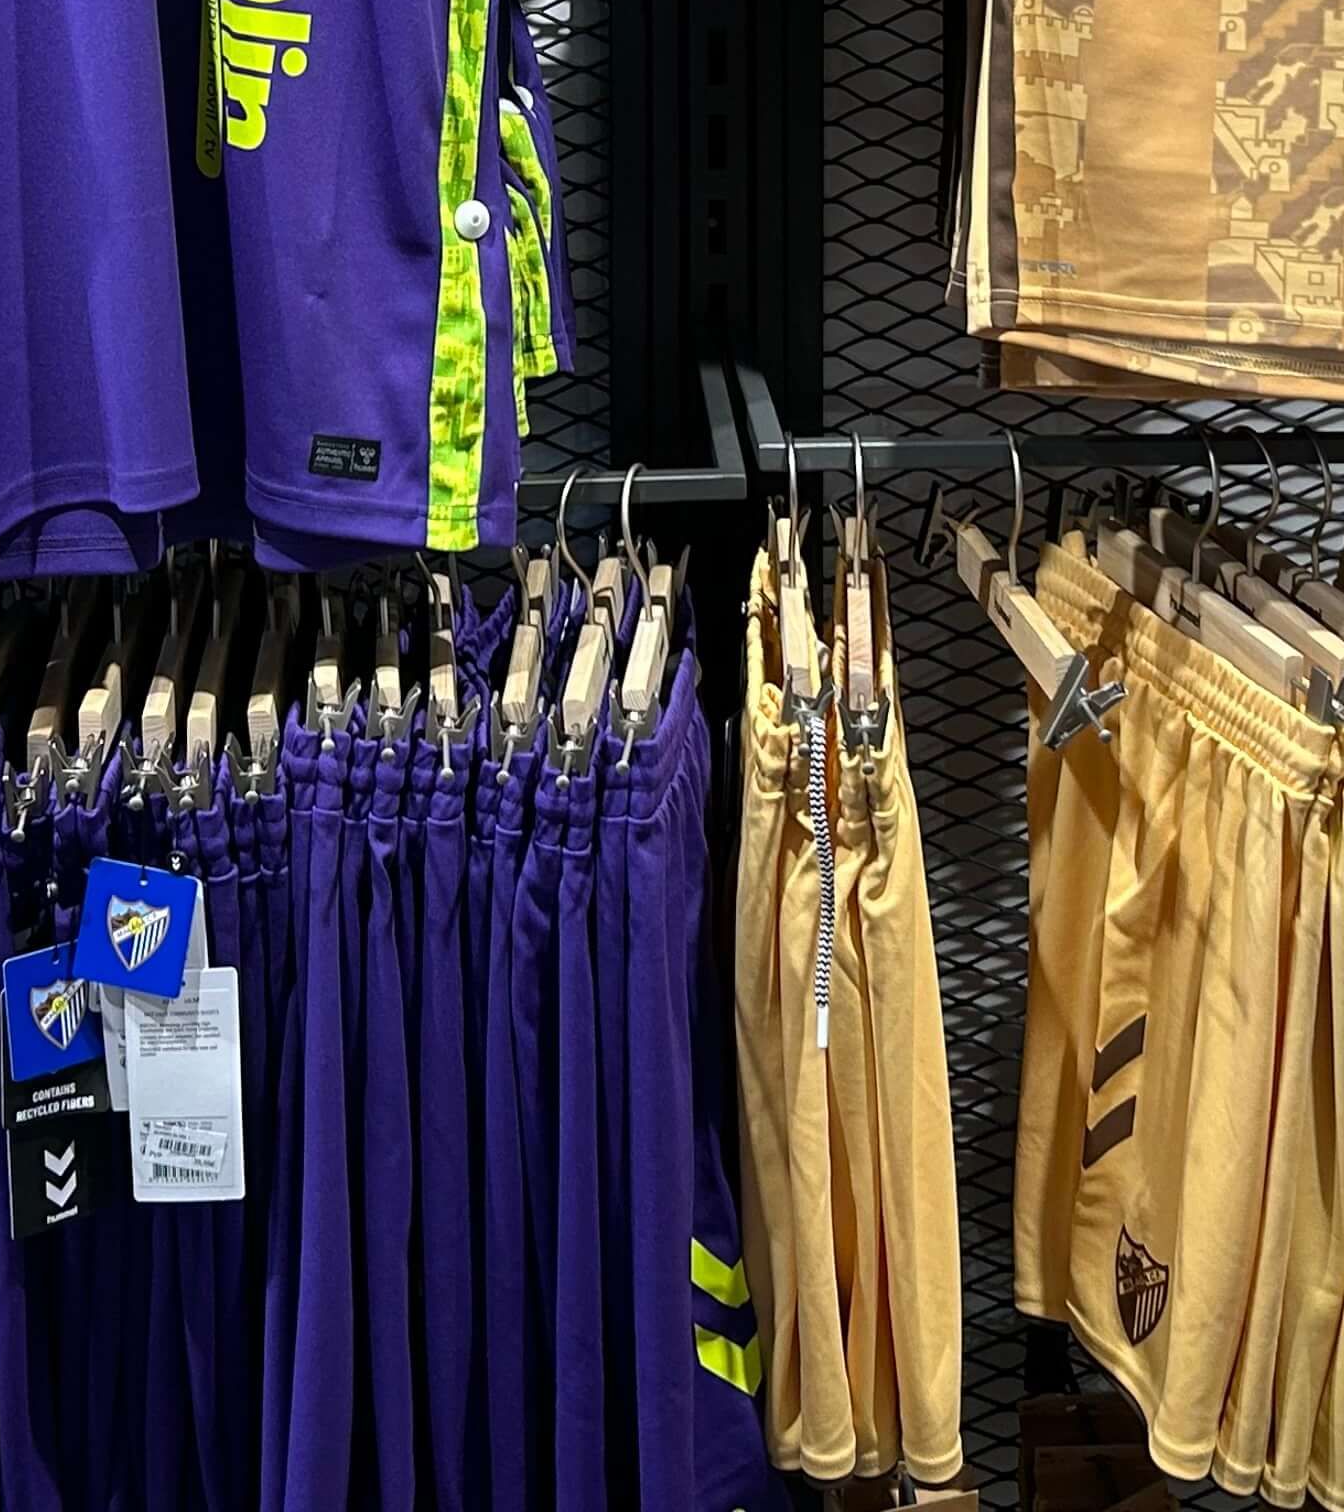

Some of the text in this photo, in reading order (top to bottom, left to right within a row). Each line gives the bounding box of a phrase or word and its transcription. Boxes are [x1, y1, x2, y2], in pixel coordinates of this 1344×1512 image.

[32, 1082, 76, 1103] CONTAINS
[16, 1095, 94, 1122] RECYCLED FIBERS
